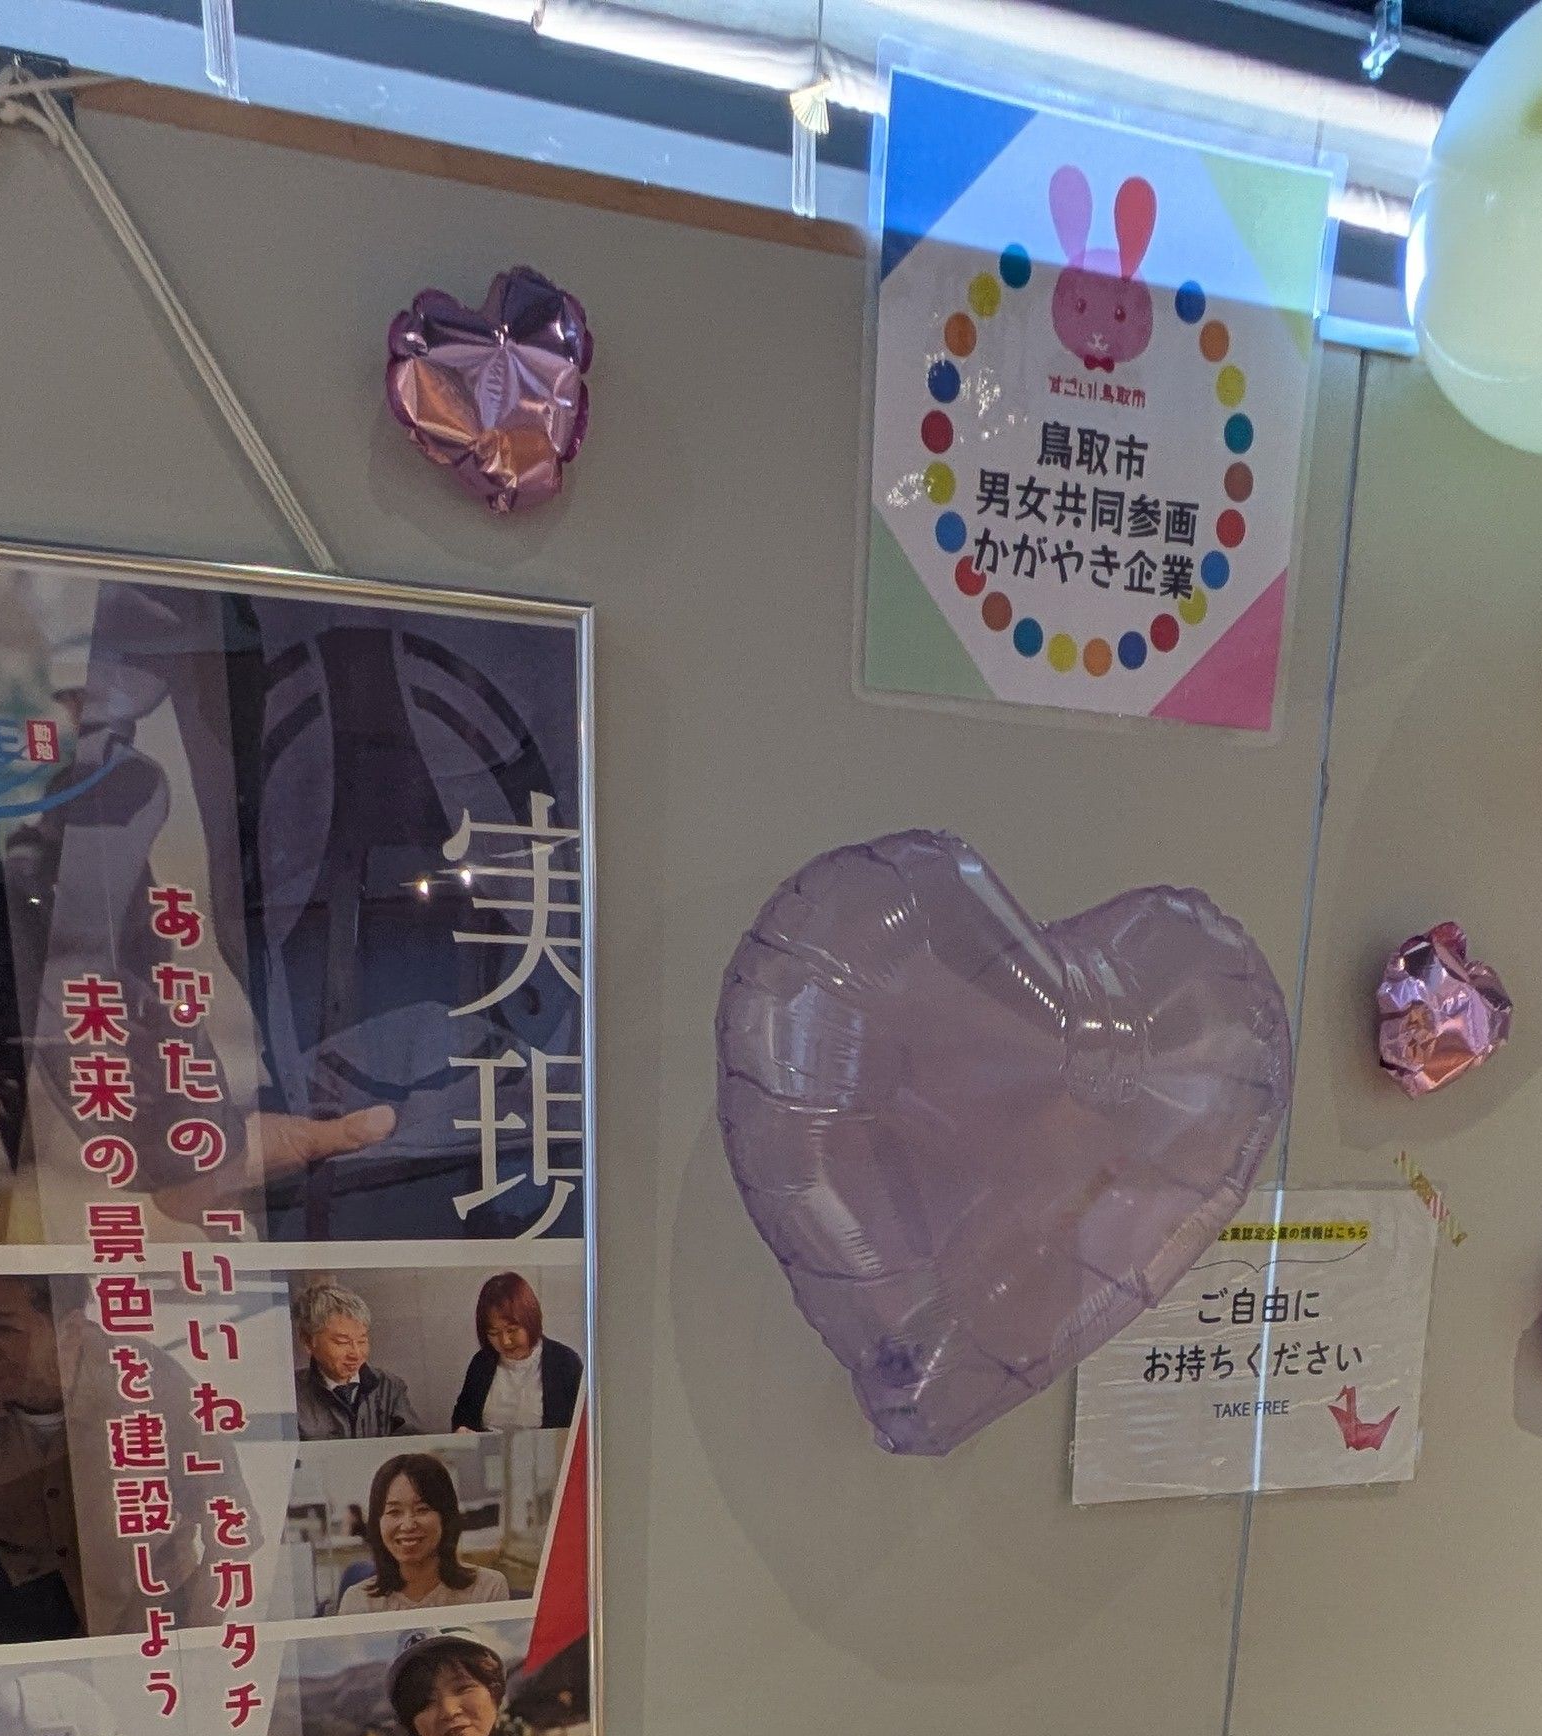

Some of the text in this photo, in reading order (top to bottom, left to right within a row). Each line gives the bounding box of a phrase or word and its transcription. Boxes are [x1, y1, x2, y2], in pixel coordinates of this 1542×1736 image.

[1037, 421, 1149, 480] 鳥取市
[974, 470, 1199, 548] 男女共同参画
[973, 531, 1196, 600] かがやき企業
[442, 791, 584, 1242] 実現
[1197, 1287, 1321, 1325] ご自由に
[61, 972, 182, 1719] 未来の景色を建設しよう
[1143, 1341, 1363, 1383] お持ちください
[1213, 1399, 1290, 1419] TAKE FREE
